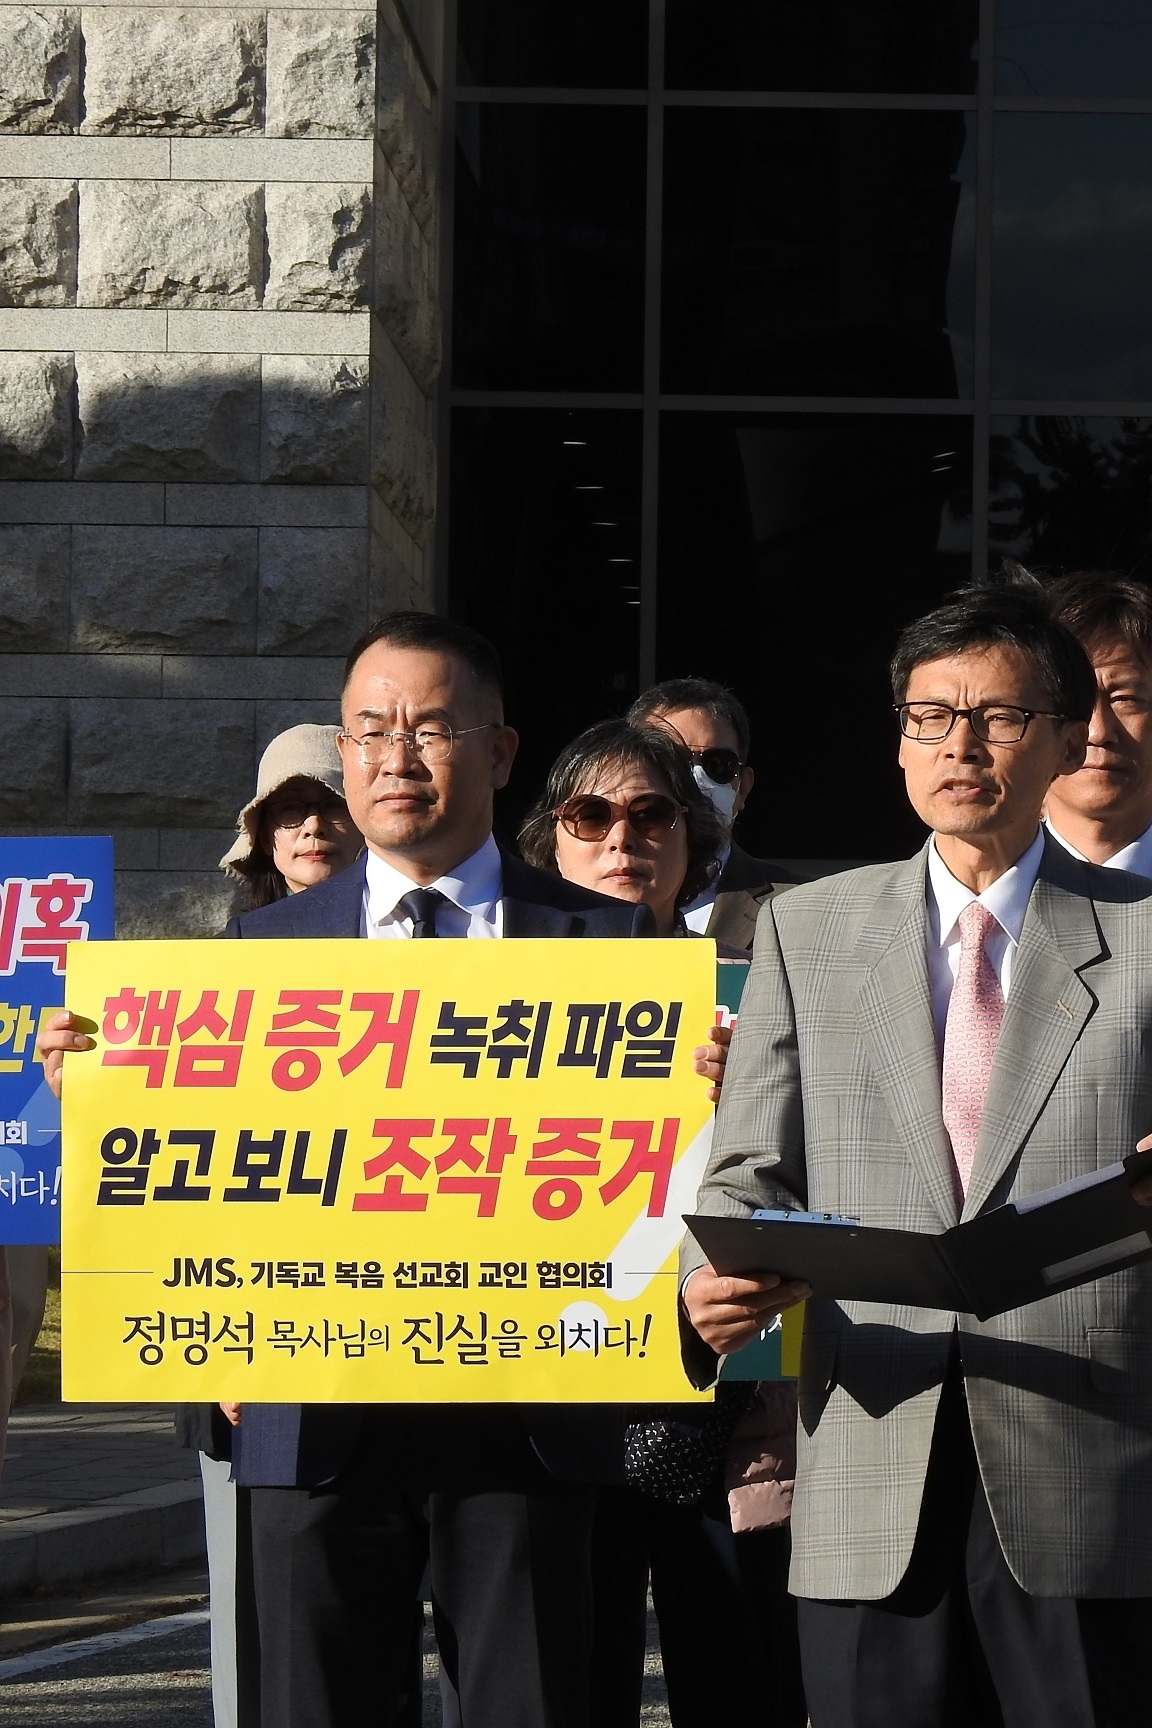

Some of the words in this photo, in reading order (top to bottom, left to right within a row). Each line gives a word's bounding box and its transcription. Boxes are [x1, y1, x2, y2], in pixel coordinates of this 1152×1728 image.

[0, 1003, 66, 1072] 한
[100, 987, 255, 1089] 핵심
[264, 989, 420, 1092] 증거
[429, 999, 548, 1079] 녹취
[557, 1000, 682, 1079] 파일
[97, 1127, 216, 1206] 알고
[223, 1128, 347, 1207] 보니
[352, 1118, 518, 1218] 조작
[524, 1118, 680, 1221] 증거
[162, 1256, 244, 1289] JMS,
[250, 1261, 325, 1289] 기독교
[333, 1261, 385, 1289] 복음
[392, 1261, 469, 1289] 선교회
[478, 1261, 528, 1289] 교인
[536, 1261, 613, 1289] 협의회
[123, 1311, 255, 1367] 정명석
[266, 1318, 390, 1359] 목사님의
[402, 1312, 527, 1366] 진실을
[535, 1313, 653, 1359] 외치다!
